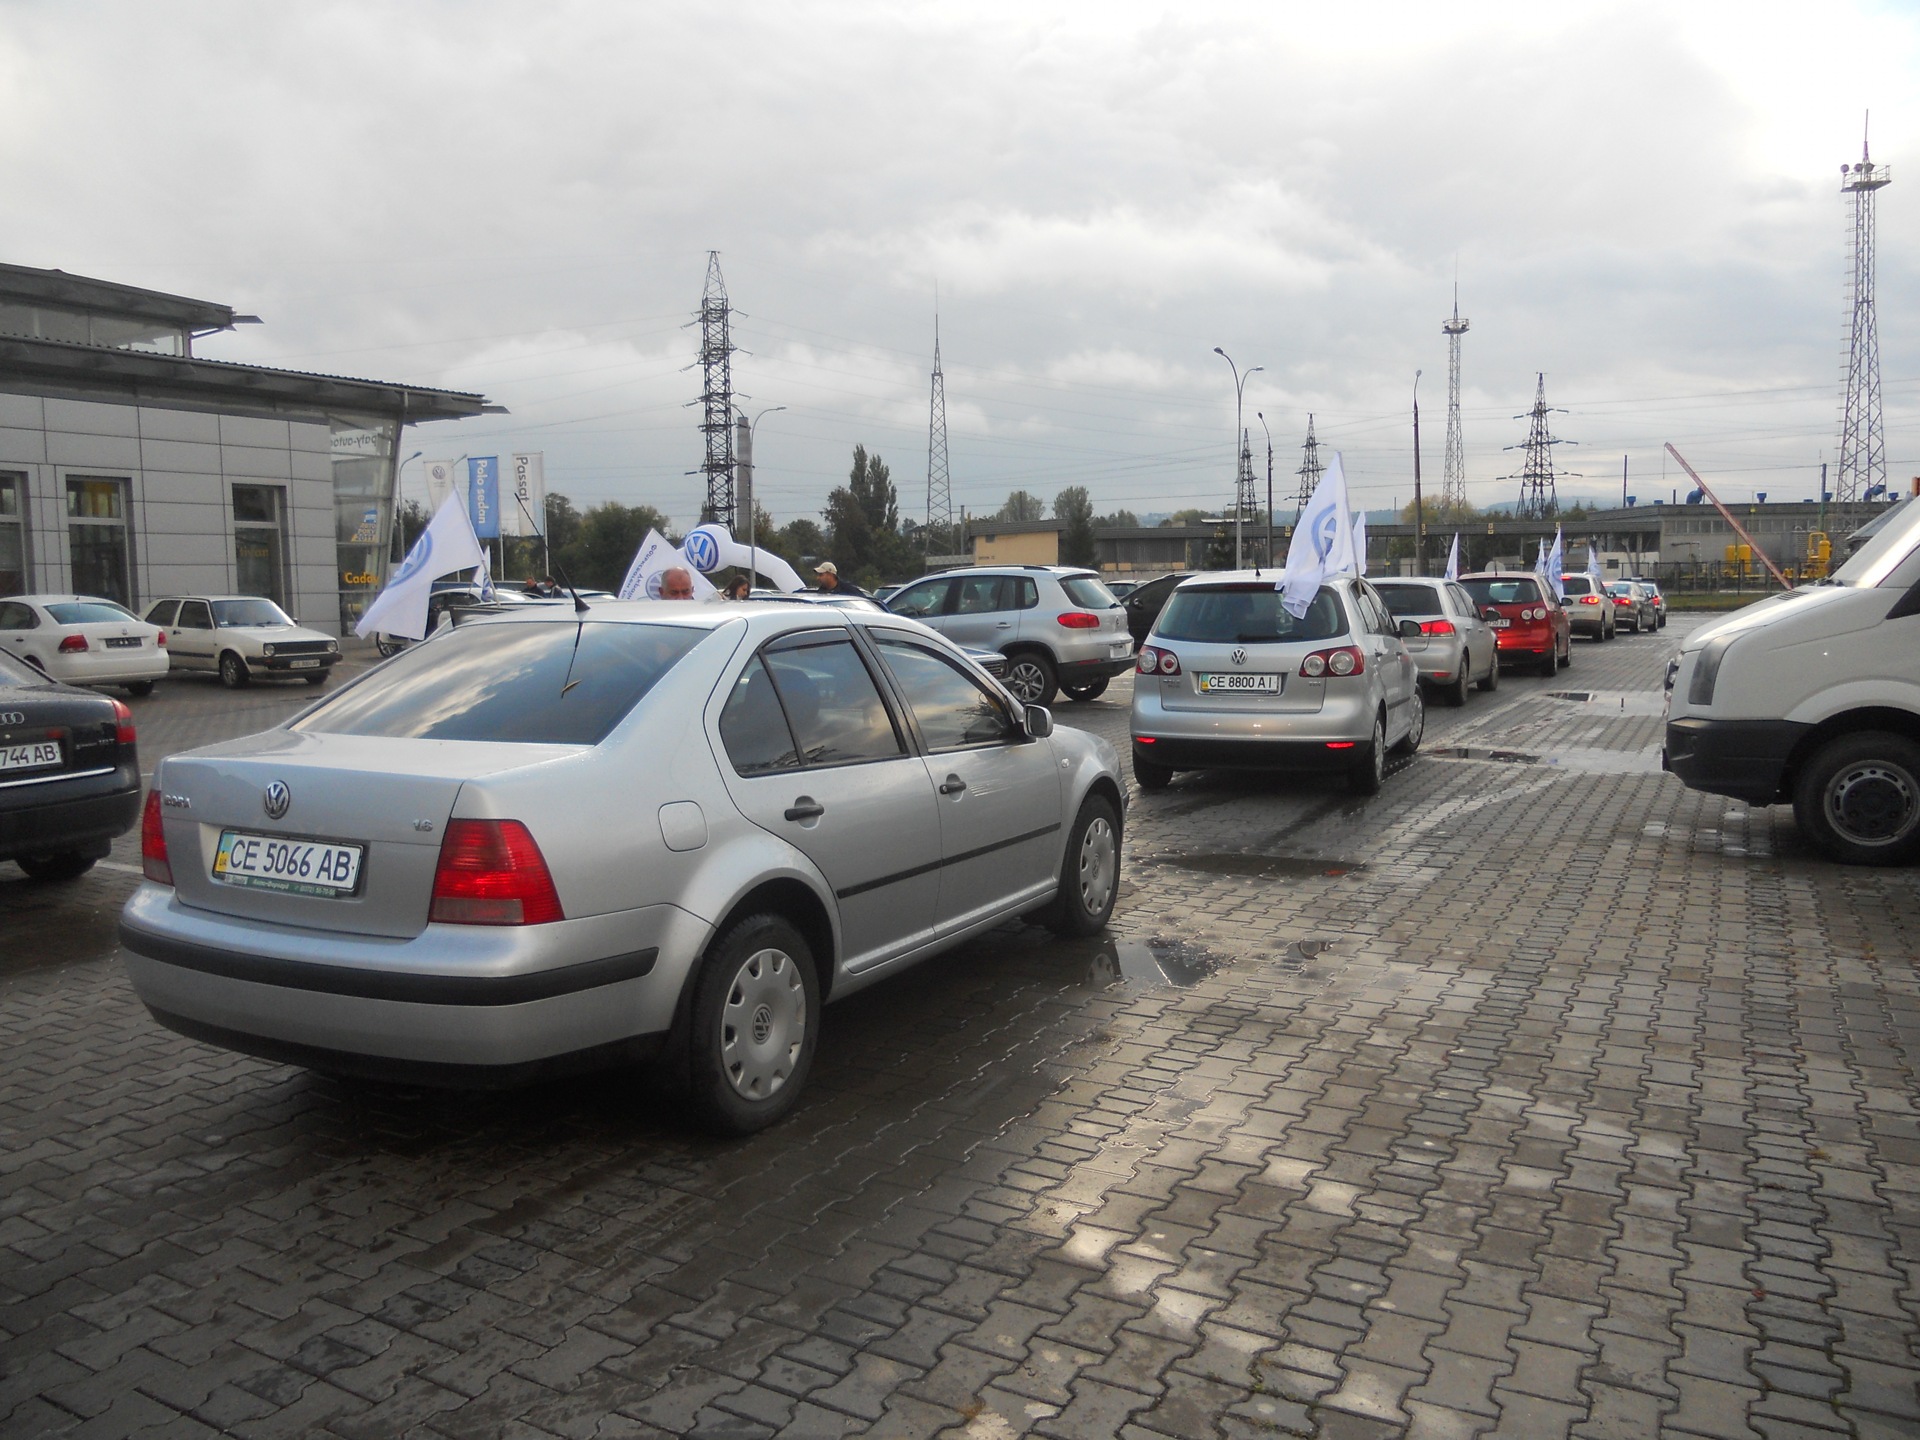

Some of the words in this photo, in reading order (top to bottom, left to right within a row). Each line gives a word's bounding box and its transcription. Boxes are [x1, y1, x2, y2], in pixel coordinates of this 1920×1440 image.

[477, 460, 489, 486] Polo
[516, 457, 530, 502] Passat
[477, 489, 490, 524] sedan
[345, 571, 379, 585] Caddy
[1208, 676, 1226, 688] CE
[1228, 676, 1255, 688] 8800
[34, 745, 56, 763] AB
[230, 840, 261, 871] CE
[263, 842, 315, 877] 5066
[315, 849, 352, 882] AB
